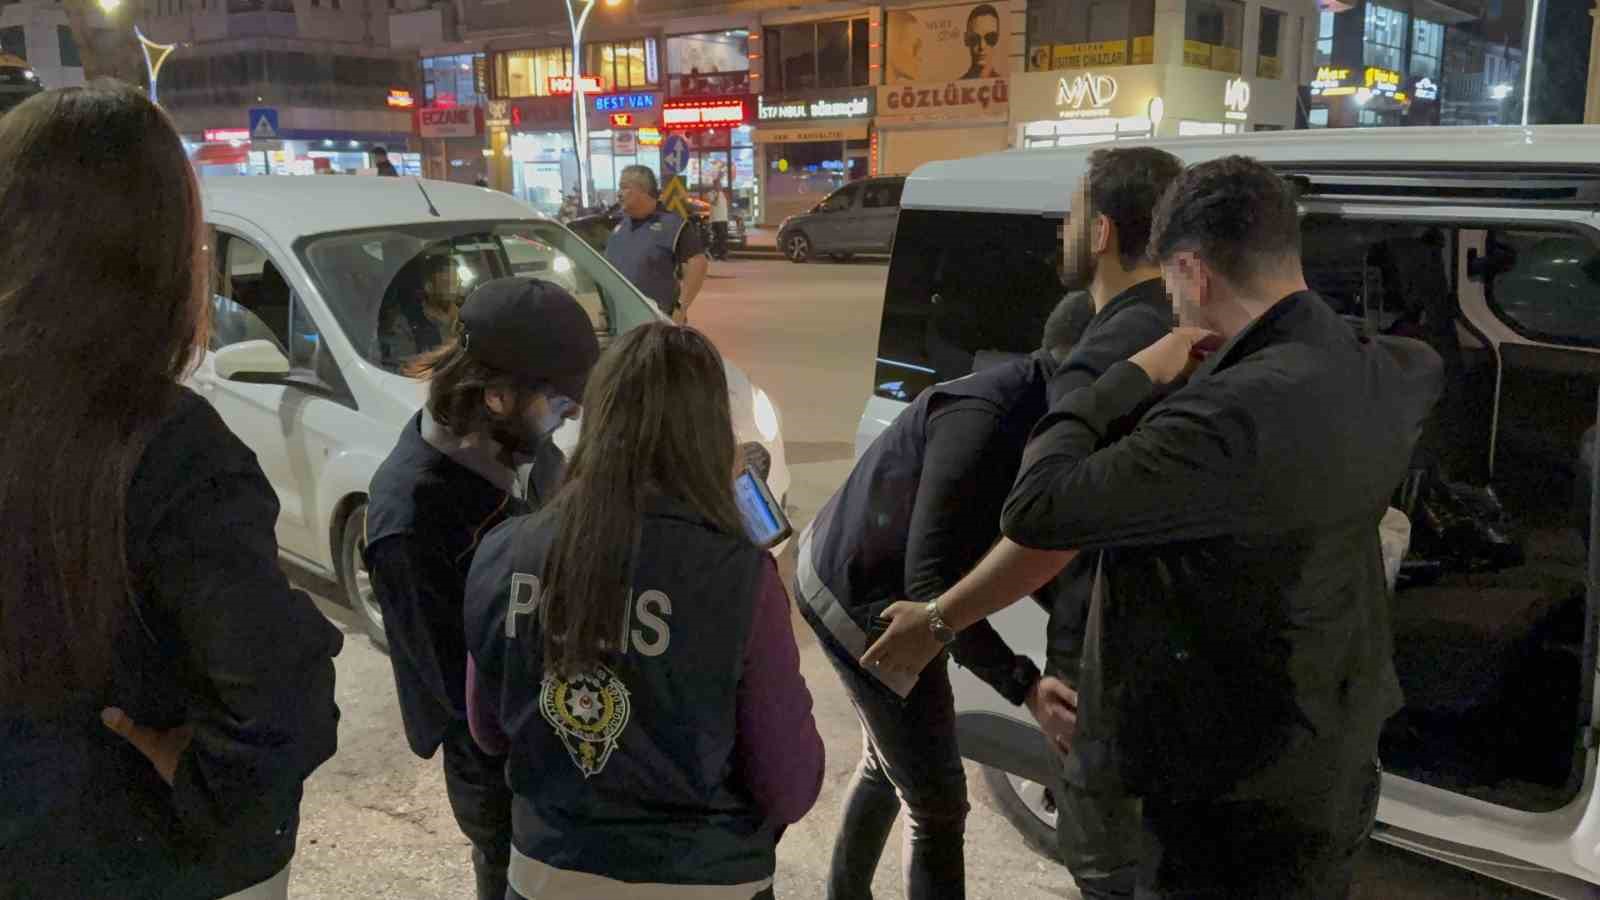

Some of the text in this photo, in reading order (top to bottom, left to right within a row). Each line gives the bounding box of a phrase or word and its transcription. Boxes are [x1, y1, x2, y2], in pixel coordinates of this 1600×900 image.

[594, 94, 653, 111] BEST VAN
[886, 80, 1008, 110] GÖZLÜKÇÜ
[1055, 71, 1118, 108] MAD
[504, 570, 673, 657] PIS
